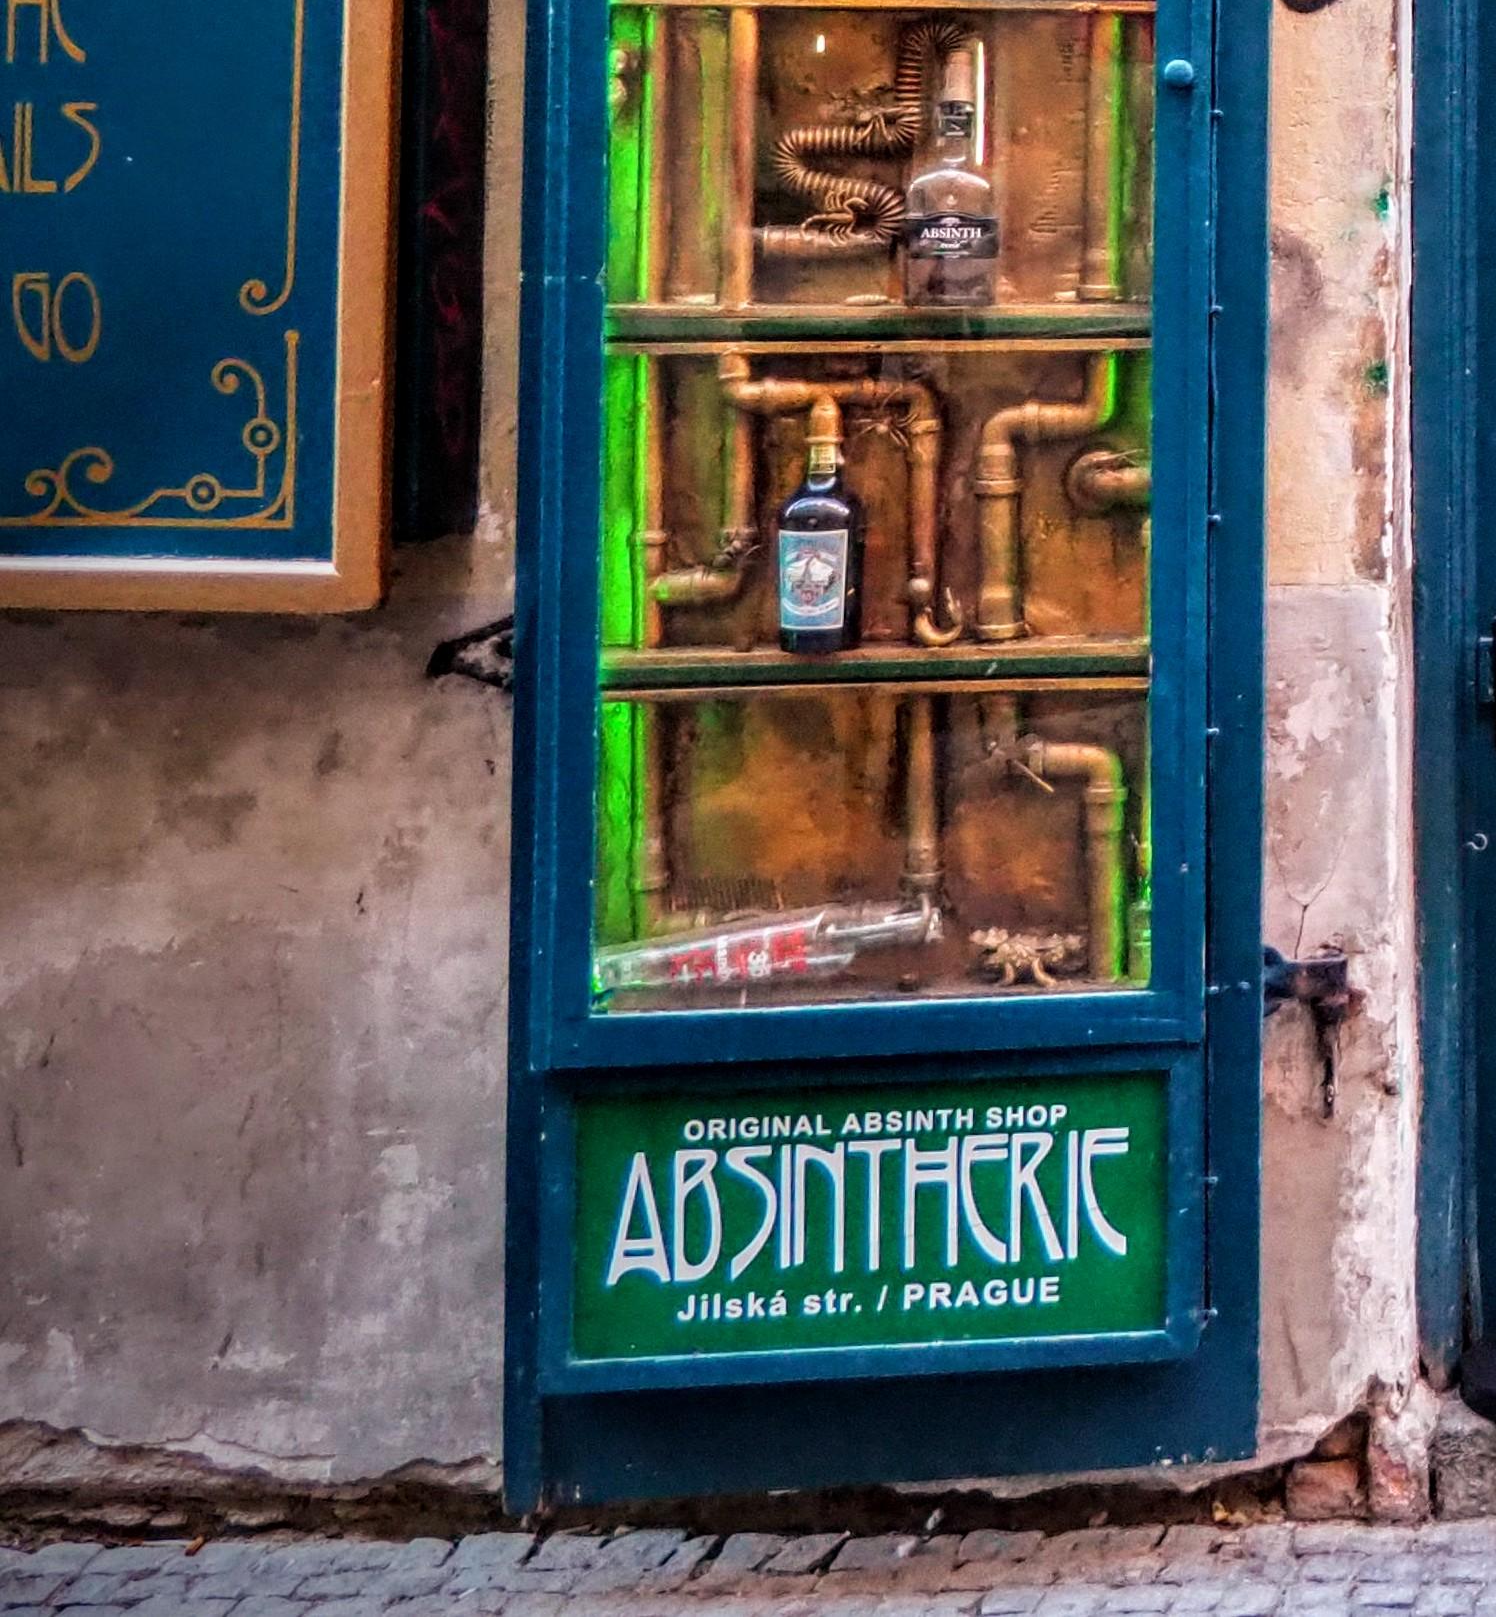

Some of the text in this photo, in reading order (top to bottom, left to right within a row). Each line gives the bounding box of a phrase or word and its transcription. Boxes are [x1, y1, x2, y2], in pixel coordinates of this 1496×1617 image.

[920, 227, 981, 239] ABSINTH
[12, 271, 102, 363] GO
[684, 1104, 1067, 1140] ORIGINAL ABSINTH SHOP
[605, 1126, 1129, 1285] ABSINTHERIE
[678, 1277, 1060, 1322] Jilská str. / PRAGUE
